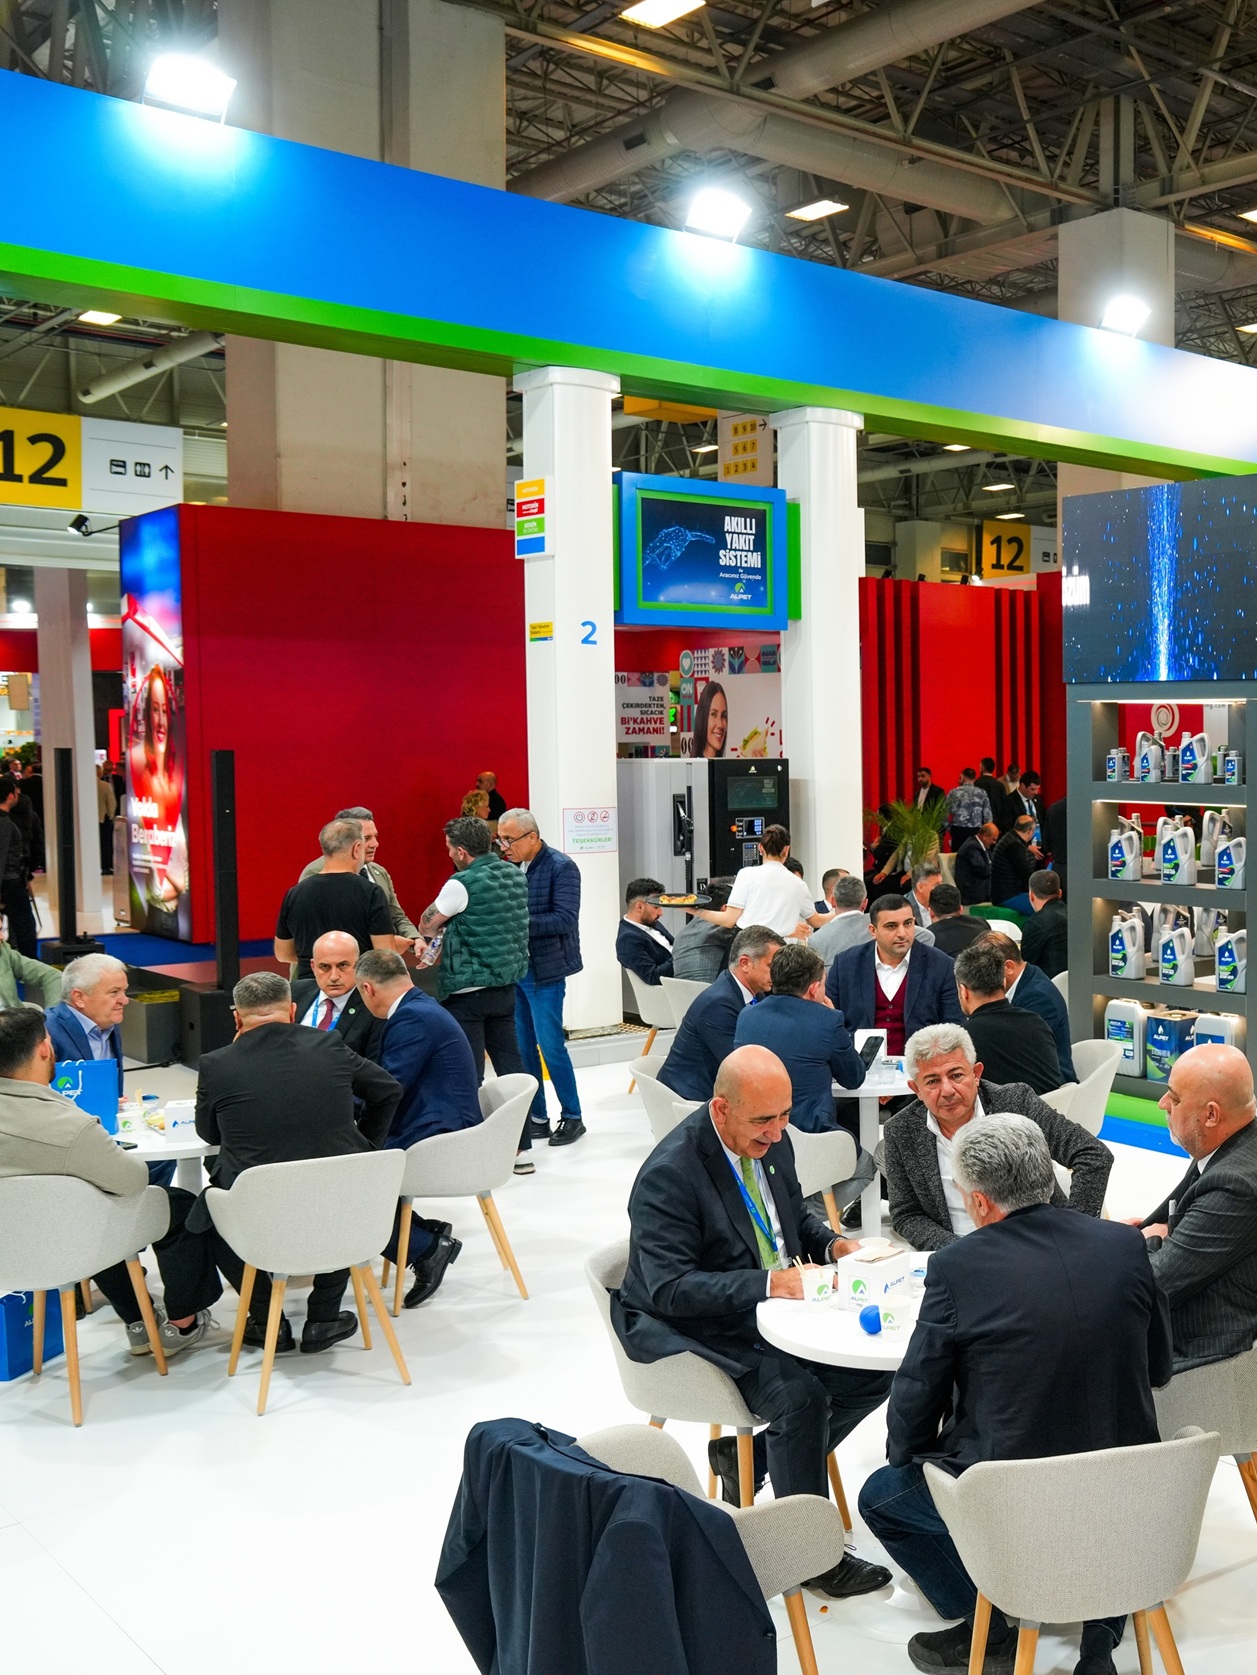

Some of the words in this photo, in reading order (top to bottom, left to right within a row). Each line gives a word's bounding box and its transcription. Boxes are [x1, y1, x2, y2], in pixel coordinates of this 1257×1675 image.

[0, 429, 68, 487] 12
[724, 515, 756, 534] AKILLI
[725, 532, 755, 551] YAKIT
[989, 534, 1025, 572] 12
[580, 620, 598, 645] 2
[625, 726, 665, 735] ZAMANI!
[890, 1276, 905, 1288] ALPET
